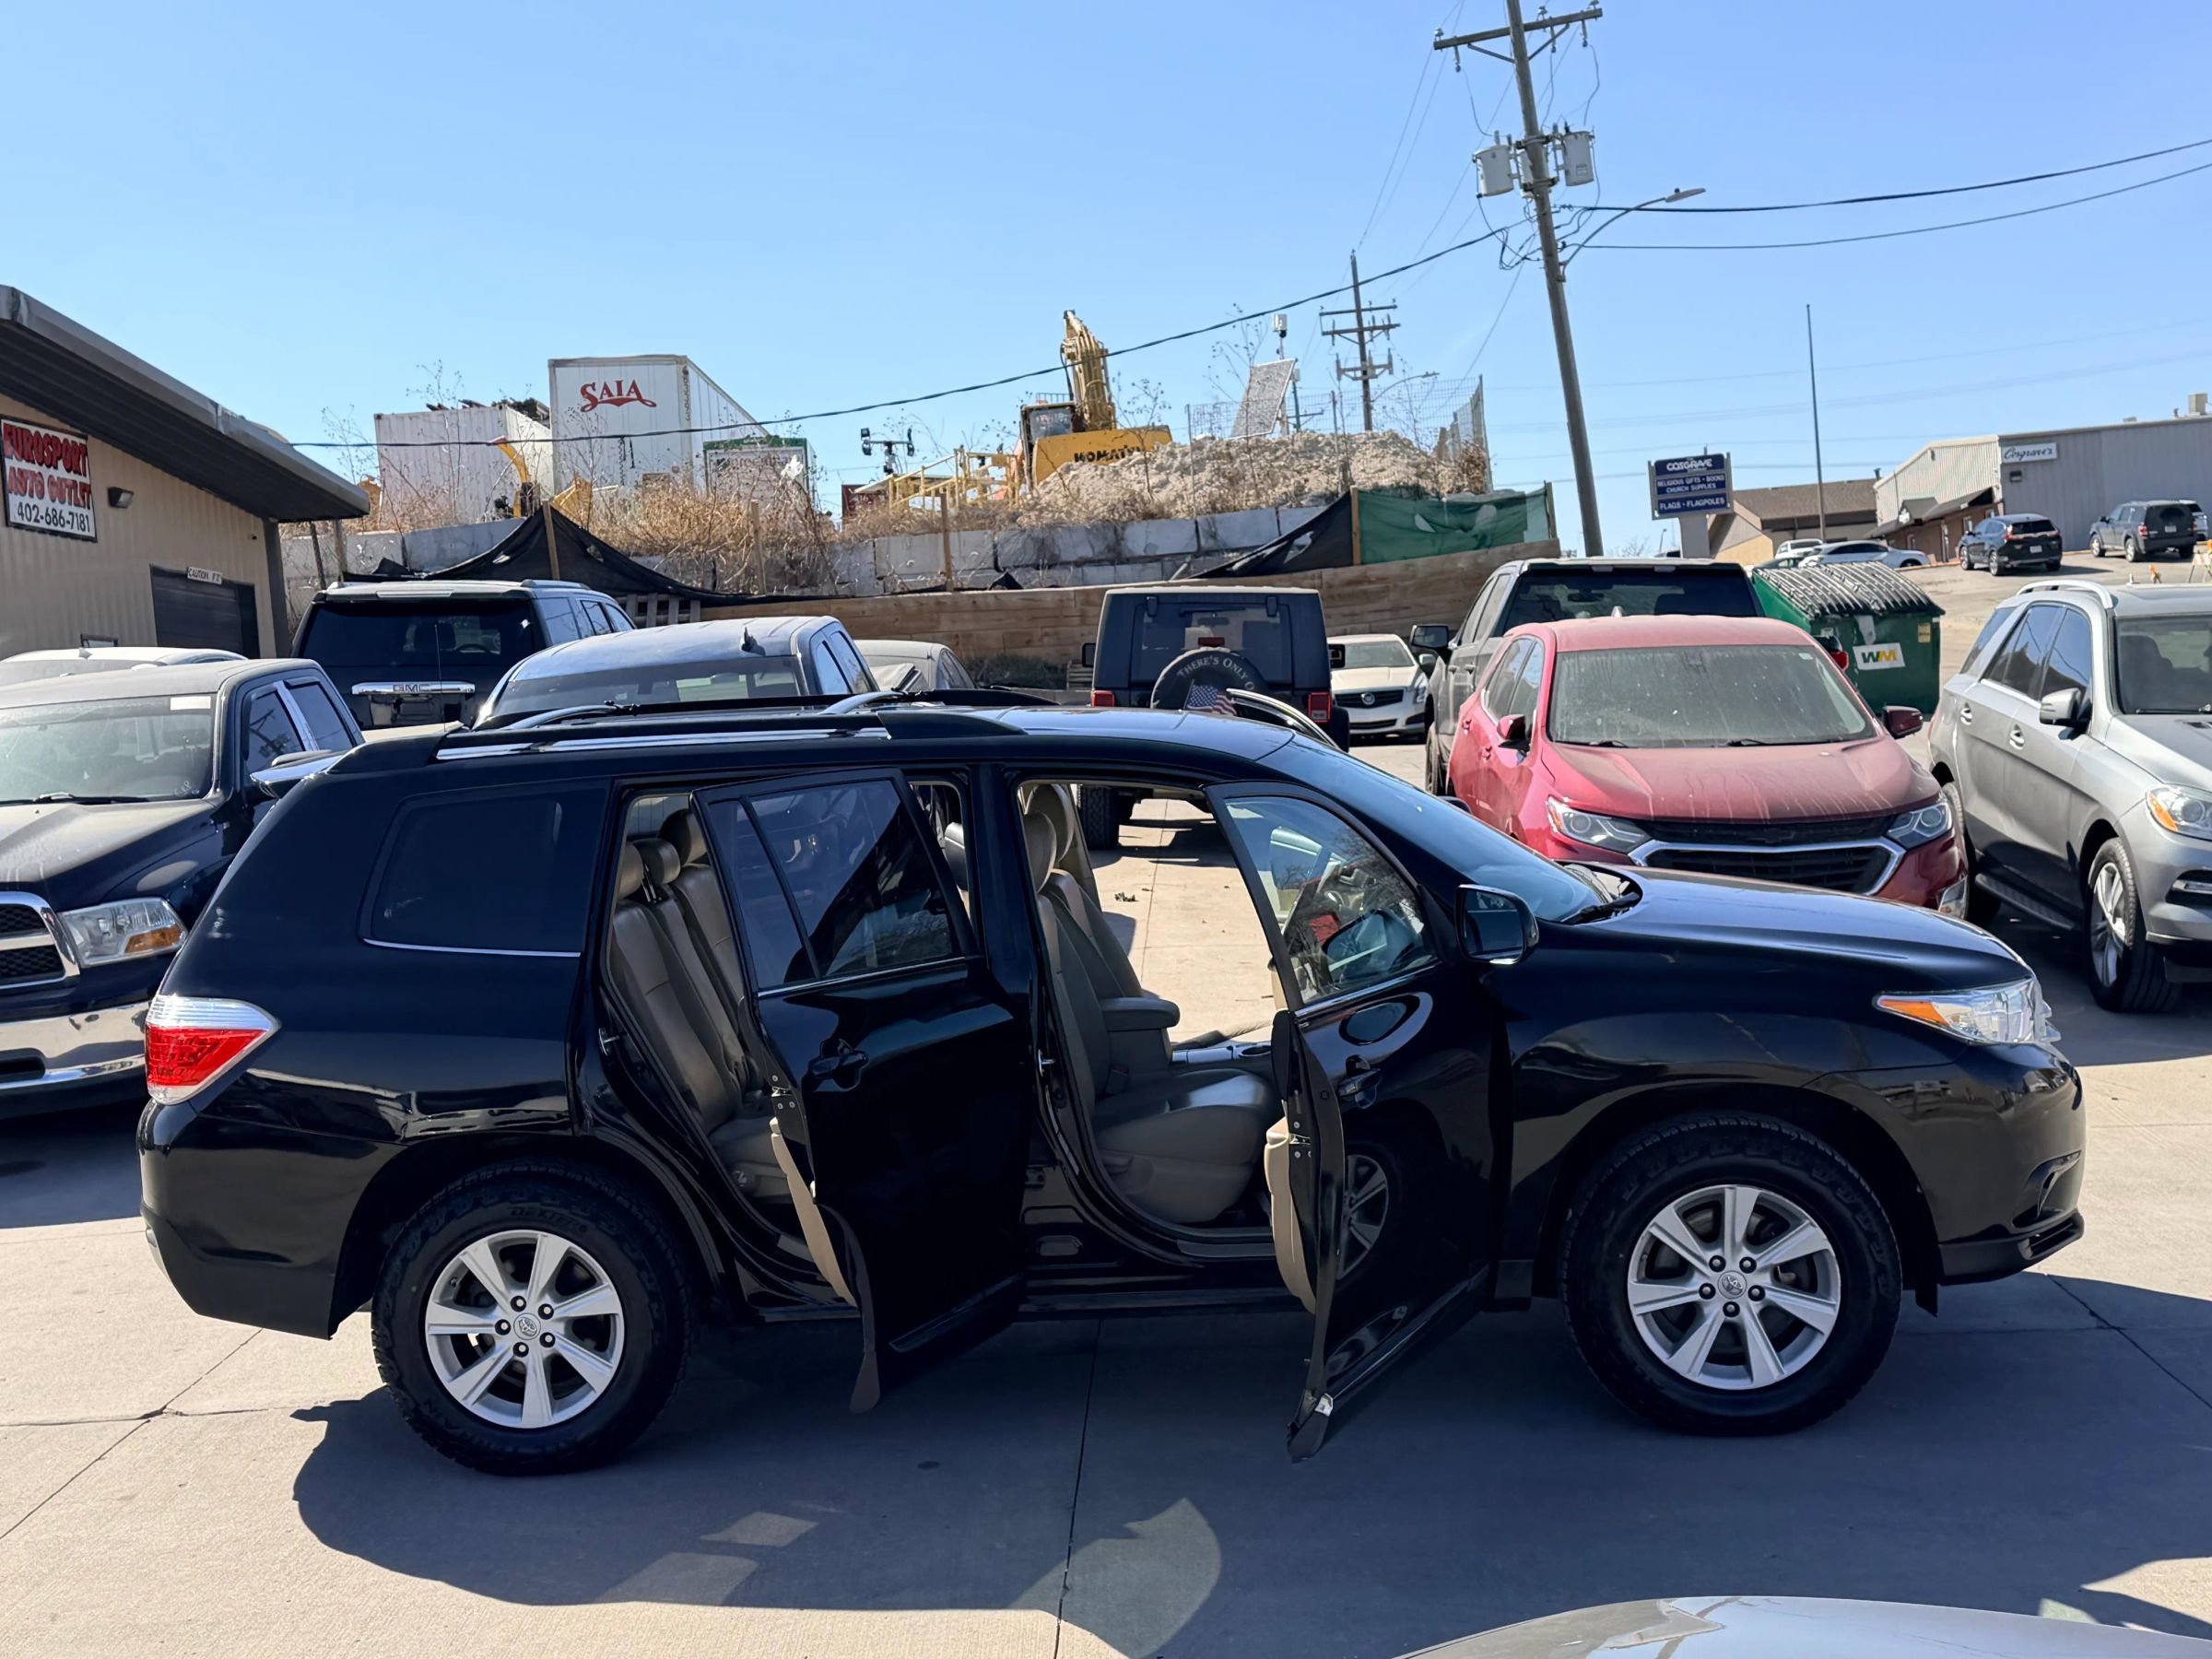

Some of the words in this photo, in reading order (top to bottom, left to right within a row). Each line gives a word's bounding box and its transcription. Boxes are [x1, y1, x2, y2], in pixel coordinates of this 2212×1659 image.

[581, 379, 656, 412] SAIA
[4, 423, 88, 477] EUROSPORT
[1666, 459, 1712, 471] COSGRAVE
[7, 466, 45, 500] AUTO
[47, 475, 91, 510] OUTLET
[1660, 501, 1681, 510] FLAGS
[1687, 497, 1725, 508] FLAGPOLES
[18, 501, 90, 533] 402-686-7181
[1177, 655, 1219, 678] THERE'S
[1223, 658, 1248, 680] ONLY
[1861, 649, 1898, 665] WM
[393, 683, 430, 692] GMC
